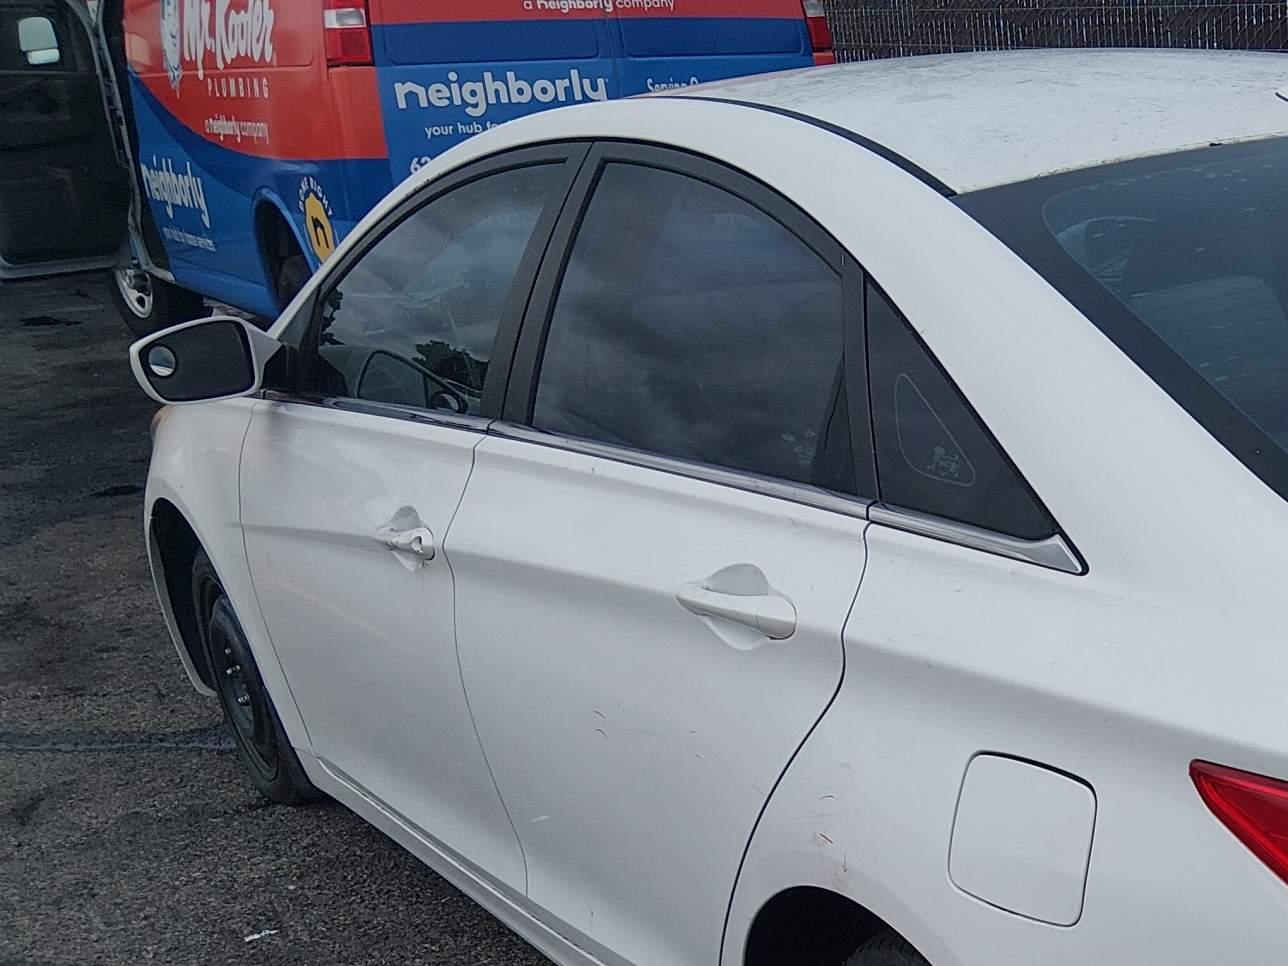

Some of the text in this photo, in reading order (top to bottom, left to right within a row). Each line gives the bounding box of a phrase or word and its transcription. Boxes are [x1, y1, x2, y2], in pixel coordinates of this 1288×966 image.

[523, 0, 674, 13] a neighborly company
[207, 77, 269, 98] PLUMBING
[394, 69, 608, 117] neighborly
[240, 121, 269, 144] company
[425, 124, 454, 139] your
[457, 122, 483, 134] hub
[140, 154, 211, 229] neighborly
